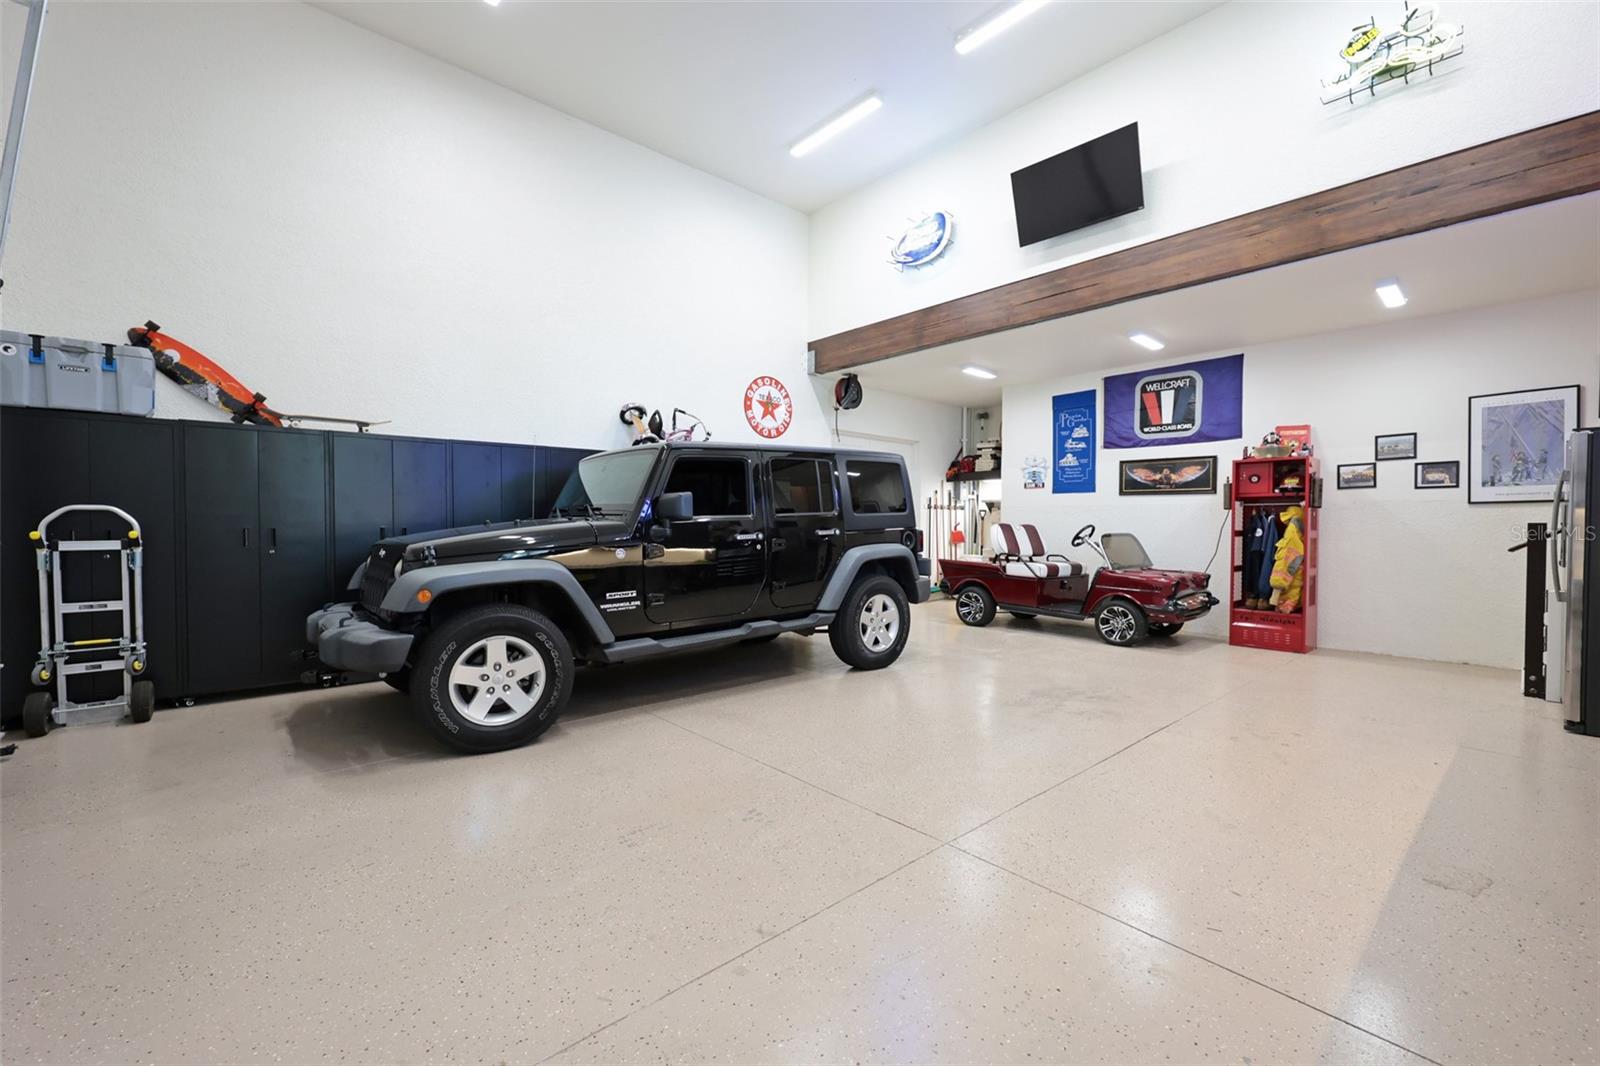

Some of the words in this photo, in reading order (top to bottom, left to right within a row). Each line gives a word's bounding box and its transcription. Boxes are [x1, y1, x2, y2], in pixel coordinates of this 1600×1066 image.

[747, 378, 790, 408] GASOLINE
[1145, 379, 1190, 392] WELLCRAFT
[746, 410, 777, 437] MOTOR
[429, 641, 460, 734] WRANGLER
